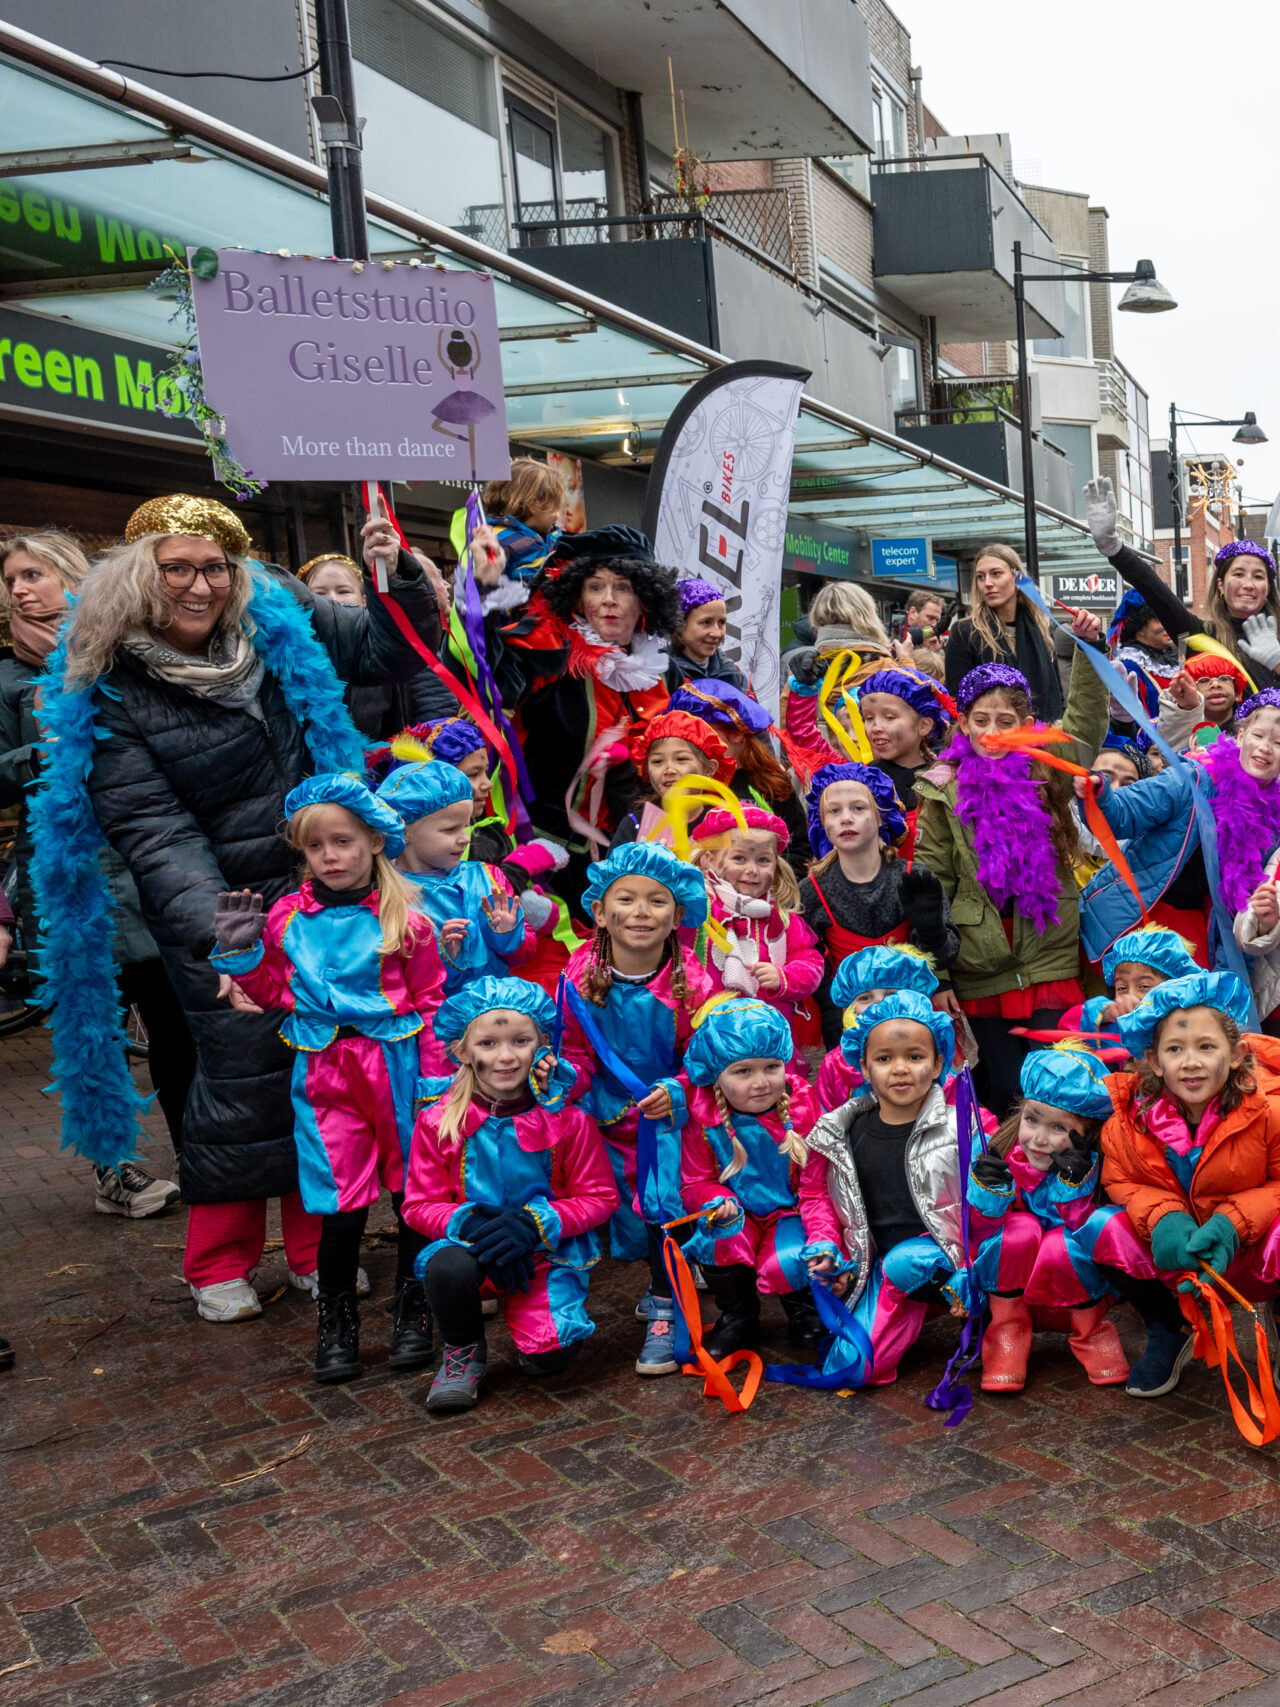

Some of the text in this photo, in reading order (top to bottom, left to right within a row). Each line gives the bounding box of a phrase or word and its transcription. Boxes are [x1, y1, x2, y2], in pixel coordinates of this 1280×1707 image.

[220, 269, 475, 328] Balletstudio
[289, 340, 433, 387] Giselle
[114, 353, 192, 417] Mo
[281, 435, 455, 458] More than dance
[721, 450, 735, 505] BIKES
[785, 532, 822, 565] Mobility
[823, 541, 850, 565] Center
[881, 546, 919, 556] telecom
[885, 557, 916, 567] expert
[1058, 577, 1078, 592] DE
